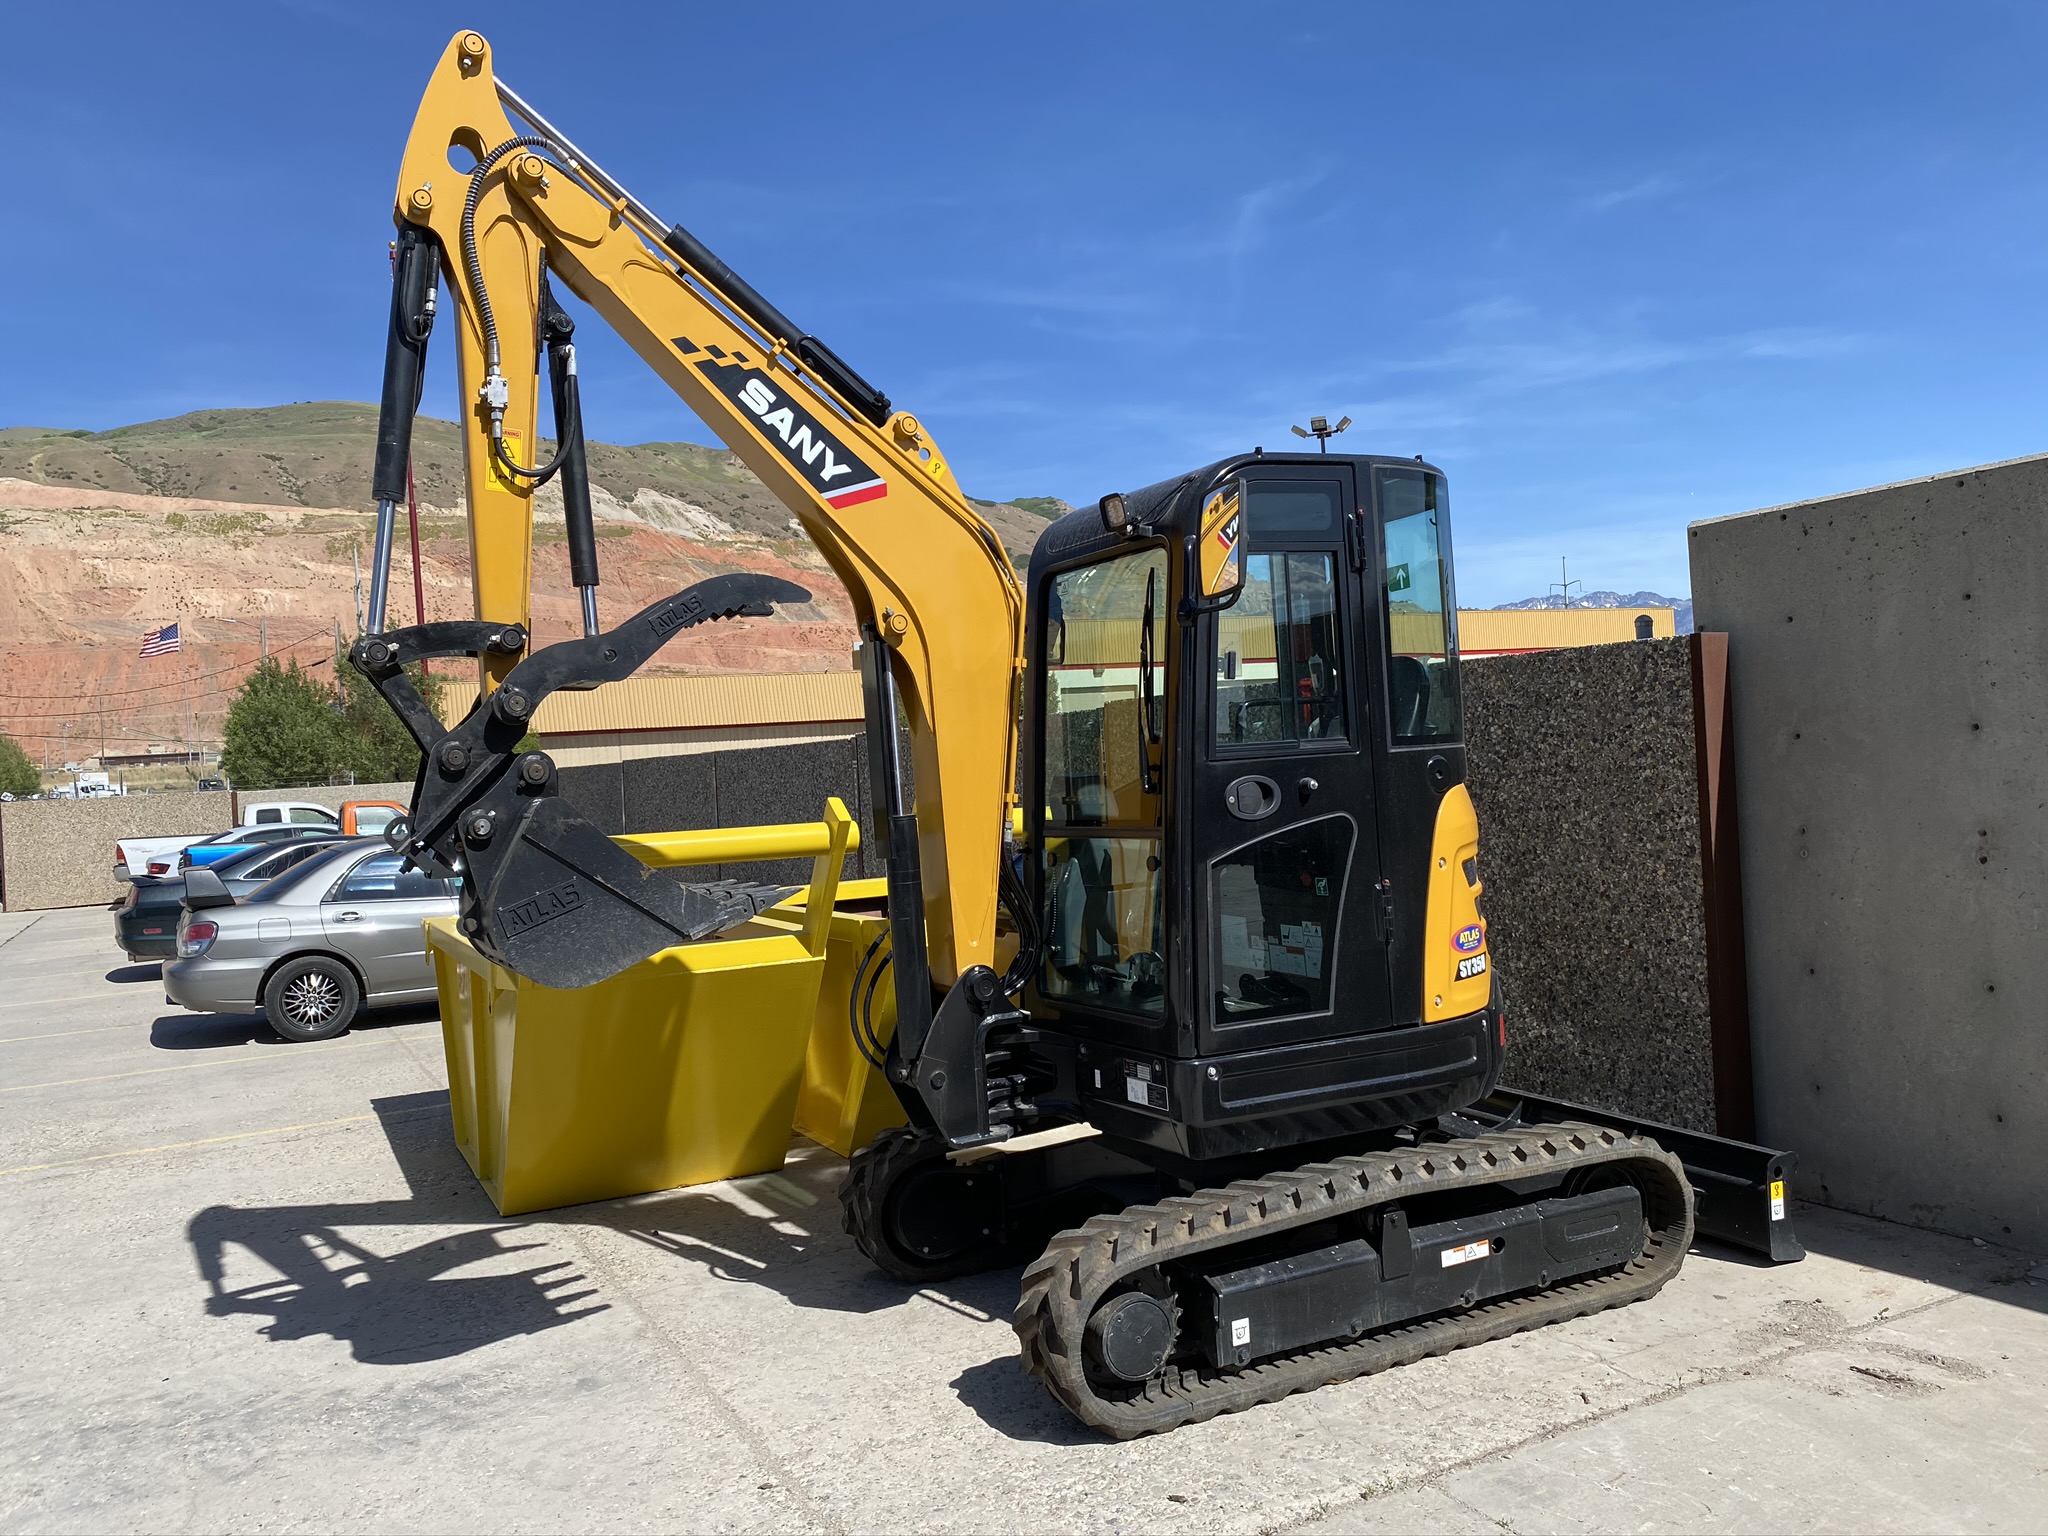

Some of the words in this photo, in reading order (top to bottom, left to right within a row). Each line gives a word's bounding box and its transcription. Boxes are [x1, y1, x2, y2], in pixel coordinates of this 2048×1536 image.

[738, 378, 852, 482] SANY
[655, 595, 702, 632] ATLAS
[507, 883, 580, 931] ATLAS
[1459, 928, 1480, 944] ATLAS
